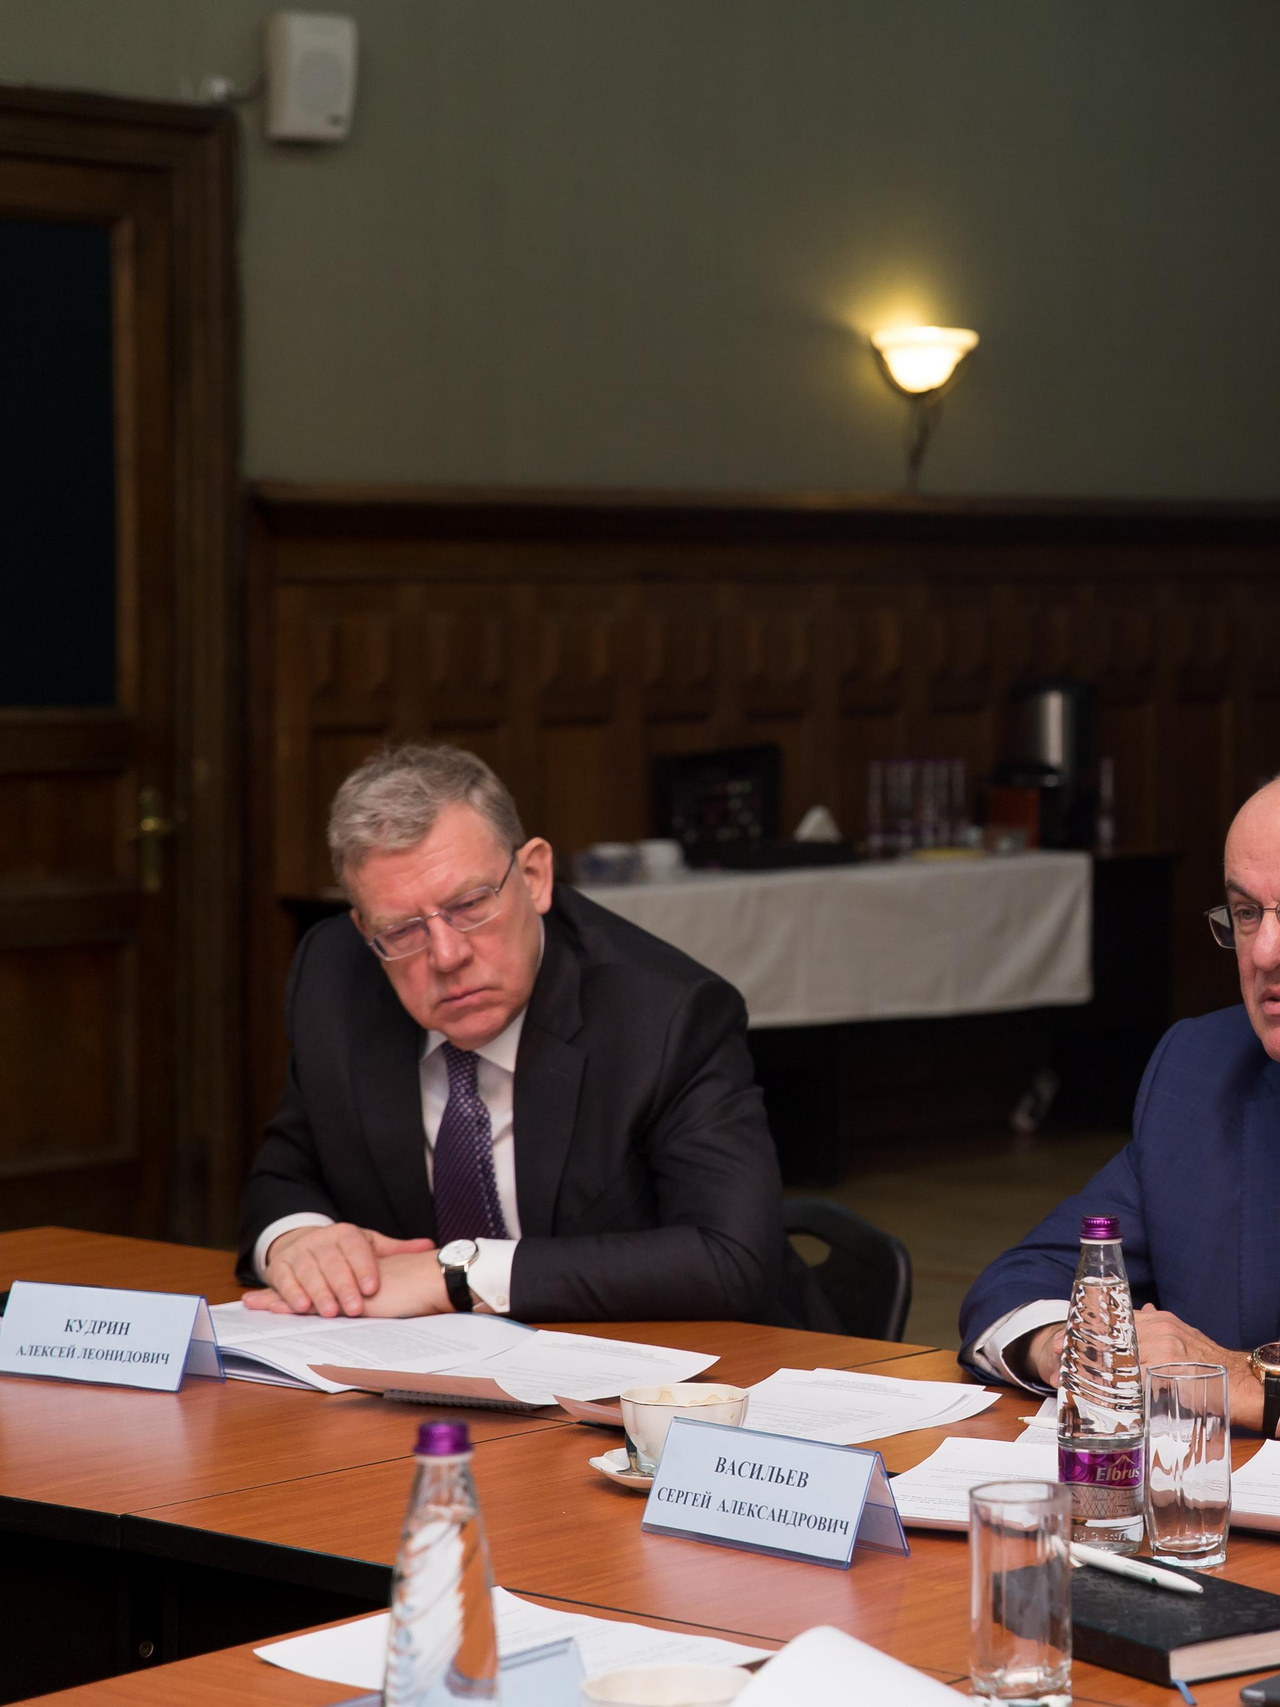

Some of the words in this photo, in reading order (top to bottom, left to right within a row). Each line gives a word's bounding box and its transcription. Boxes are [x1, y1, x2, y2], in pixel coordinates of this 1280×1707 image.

[64, 1319, 131, 1336] КУДРИН
[16, 1344, 76, 1359] АЛЕКСЕЙ
[78, 1347, 170, 1365] ЛЕОНИДОВИЧ
[715, 1456, 809, 1489] ВАСИЛЬЕВ
[1095, 1466, 1140, 1482] Elbrus
[657, 1486, 712, 1510] СЕРГЕЙ
[716, 1498, 850, 1536] АЛЕКСАНДРОВИЧ
